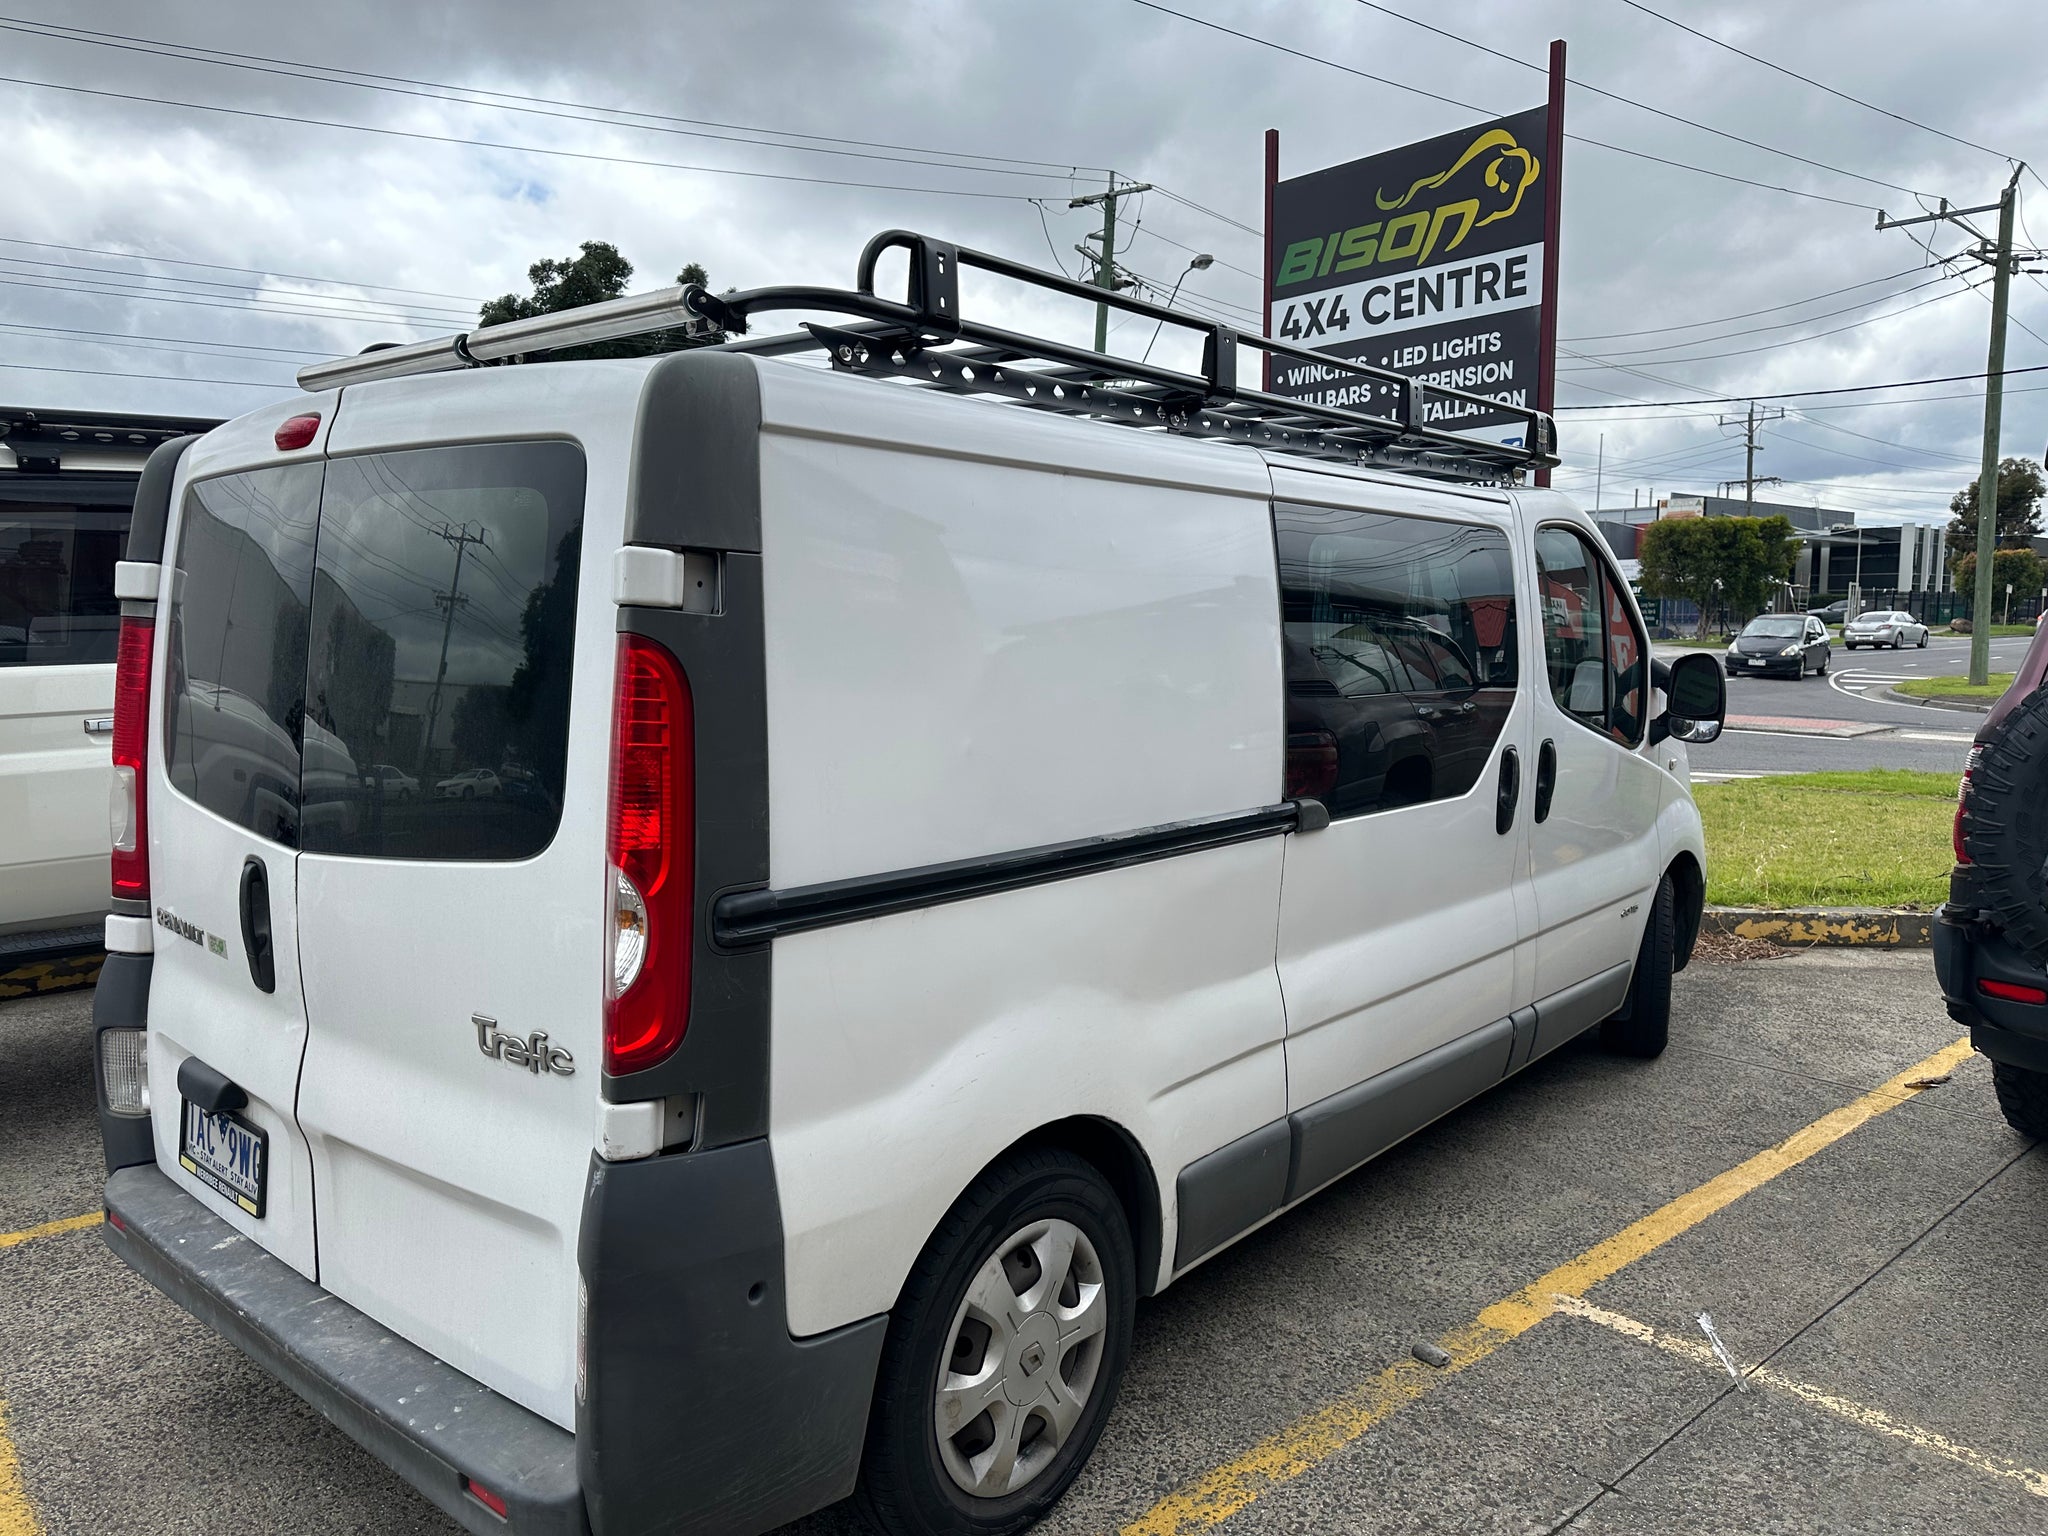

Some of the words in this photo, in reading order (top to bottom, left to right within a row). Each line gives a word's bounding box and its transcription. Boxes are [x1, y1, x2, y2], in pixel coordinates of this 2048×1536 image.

[1276, 198, 1480, 287] BISON
[1279, 294, 1350, 341] 4X4
[1361, 254, 1528, 325] CENTRE
[1393, 345, 1428, 369] LED
[1432, 331, 1502, 362] LIGHTS
[1287, 383, 1372, 408] LBARS
[1391, 359, 1514, 398] SSPENSION
[1391, 389, 1527, 423] ITALLATION
[471, 1013, 576, 1077] Trafic
[230, 1171, 244, 1186] STAY
[244, 1180, 259, 1196] ALIV
